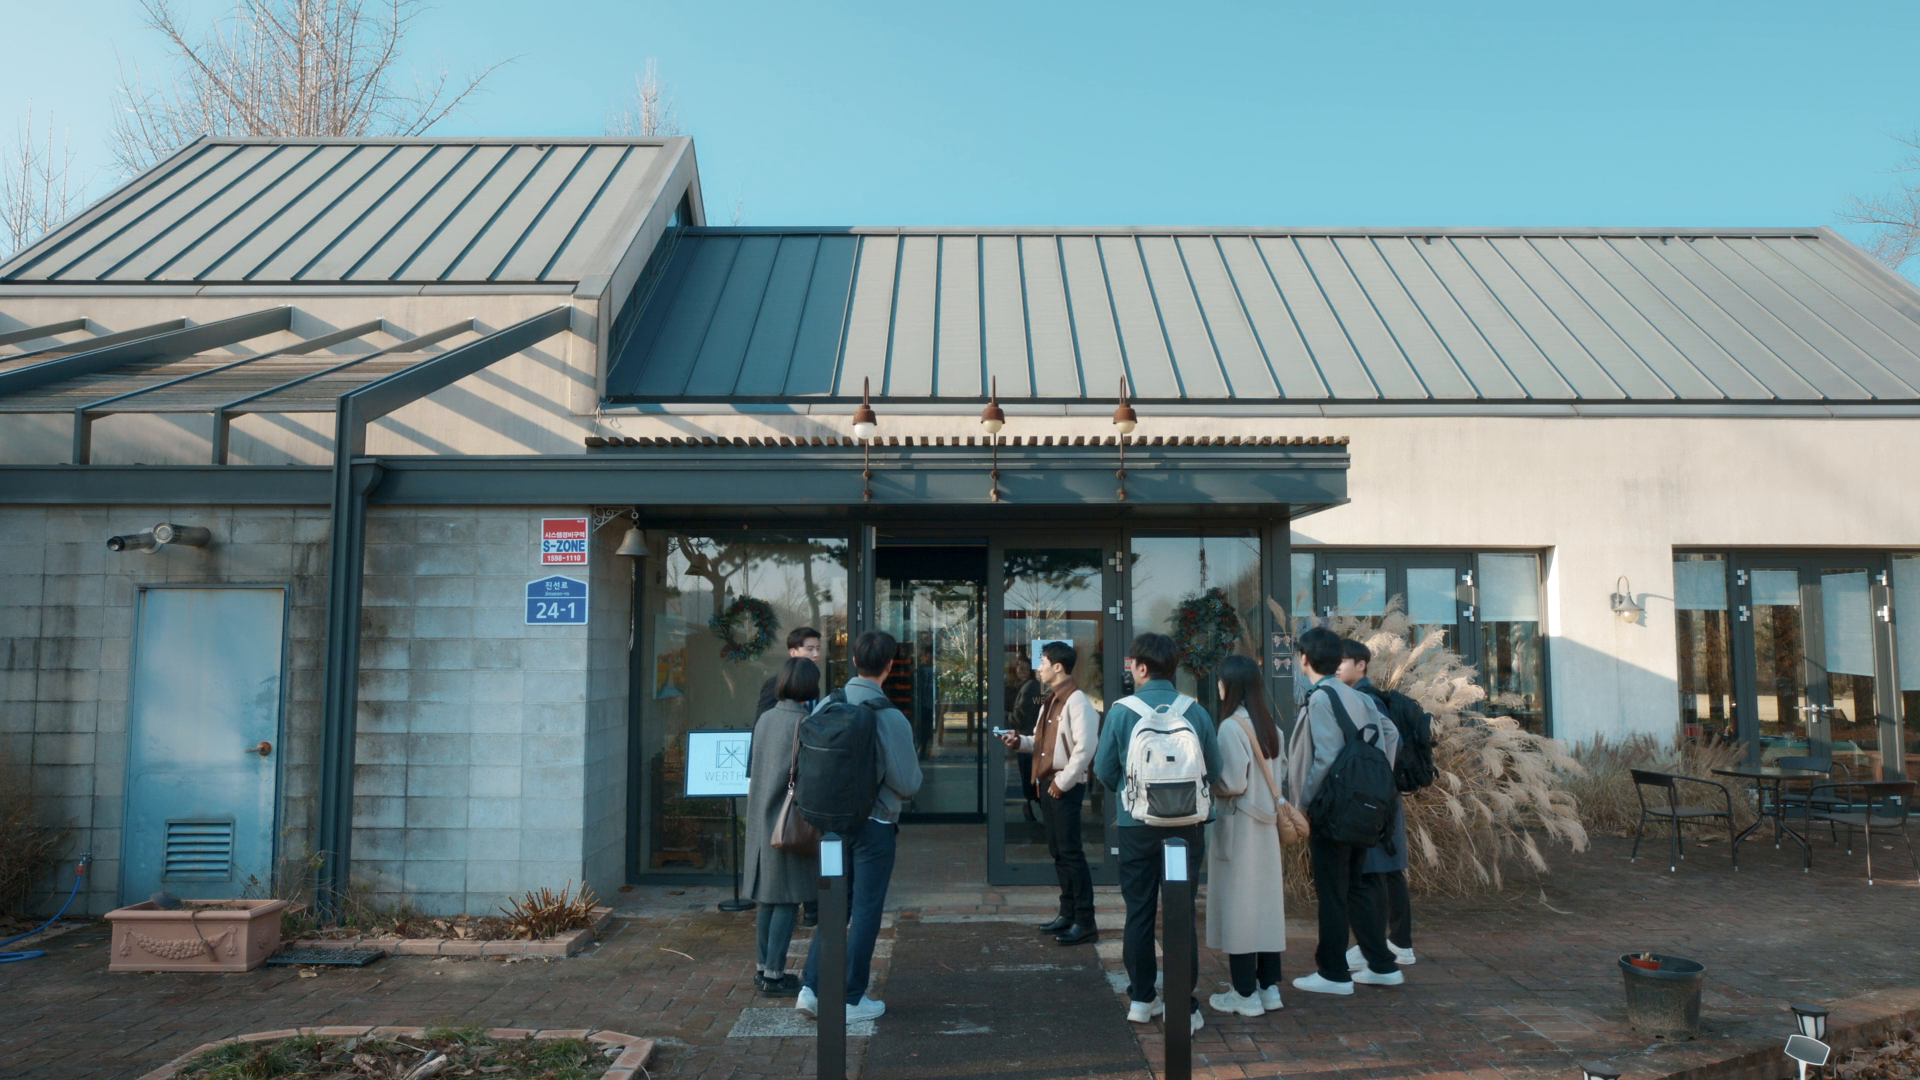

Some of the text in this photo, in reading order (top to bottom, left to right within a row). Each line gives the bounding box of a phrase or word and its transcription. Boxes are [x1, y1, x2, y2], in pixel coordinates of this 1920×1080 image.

[544, 531, 586, 539] 시스템경비구역
[543, 540, 586, 553] S-ZONE
[545, 581, 569, 591] 진선로
[536, 602, 576, 619] 24-1
[704, 771, 747, 782] WERTH
